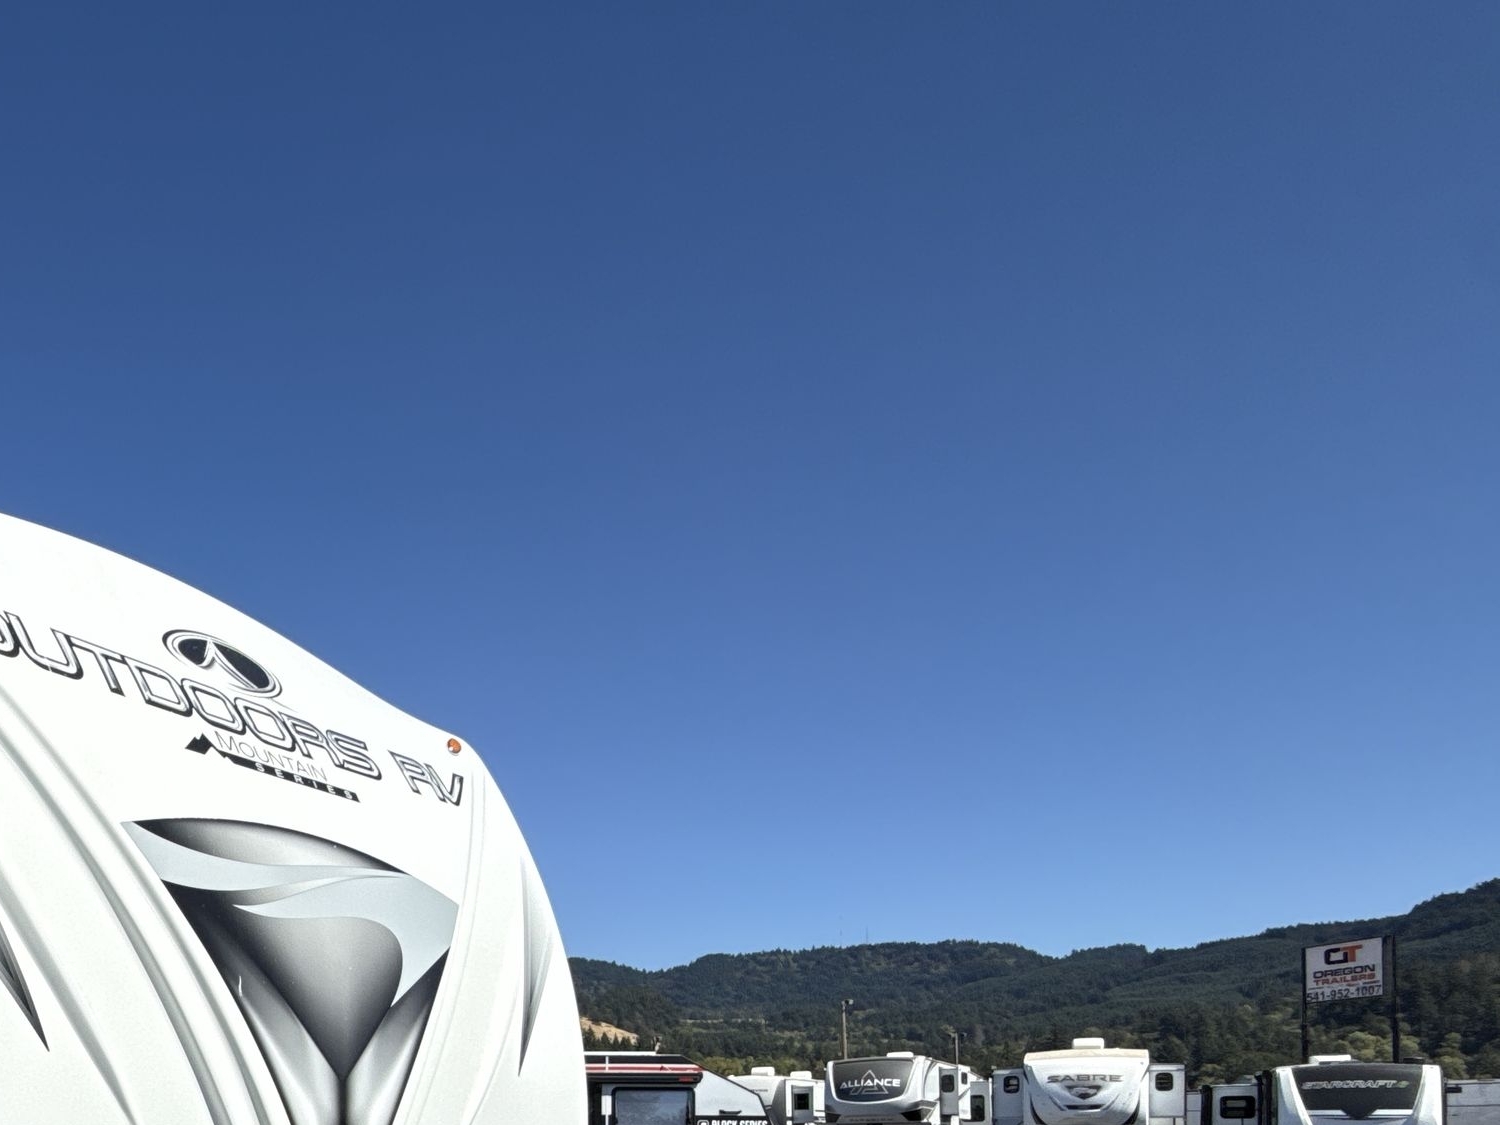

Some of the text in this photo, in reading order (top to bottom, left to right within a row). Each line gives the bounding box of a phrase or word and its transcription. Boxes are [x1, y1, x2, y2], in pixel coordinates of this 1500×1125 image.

[214, 730, 329, 784] MOUNTAIN
[254, 761, 354, 800] SERIES
[388, 749, 465, 806] RV
[1313, 964, 1375, 979] OREGON
[1314, 973, 1375, 986] TRAILERS
[1306, 984, 1381, 1001] 541-952-1007
[840, 1078, 901, 1089] ALLIANCE
[1047, 1073, 1124, 1083] SABRE
[1301, 1080, 1398, 1089] STARCRAFT
